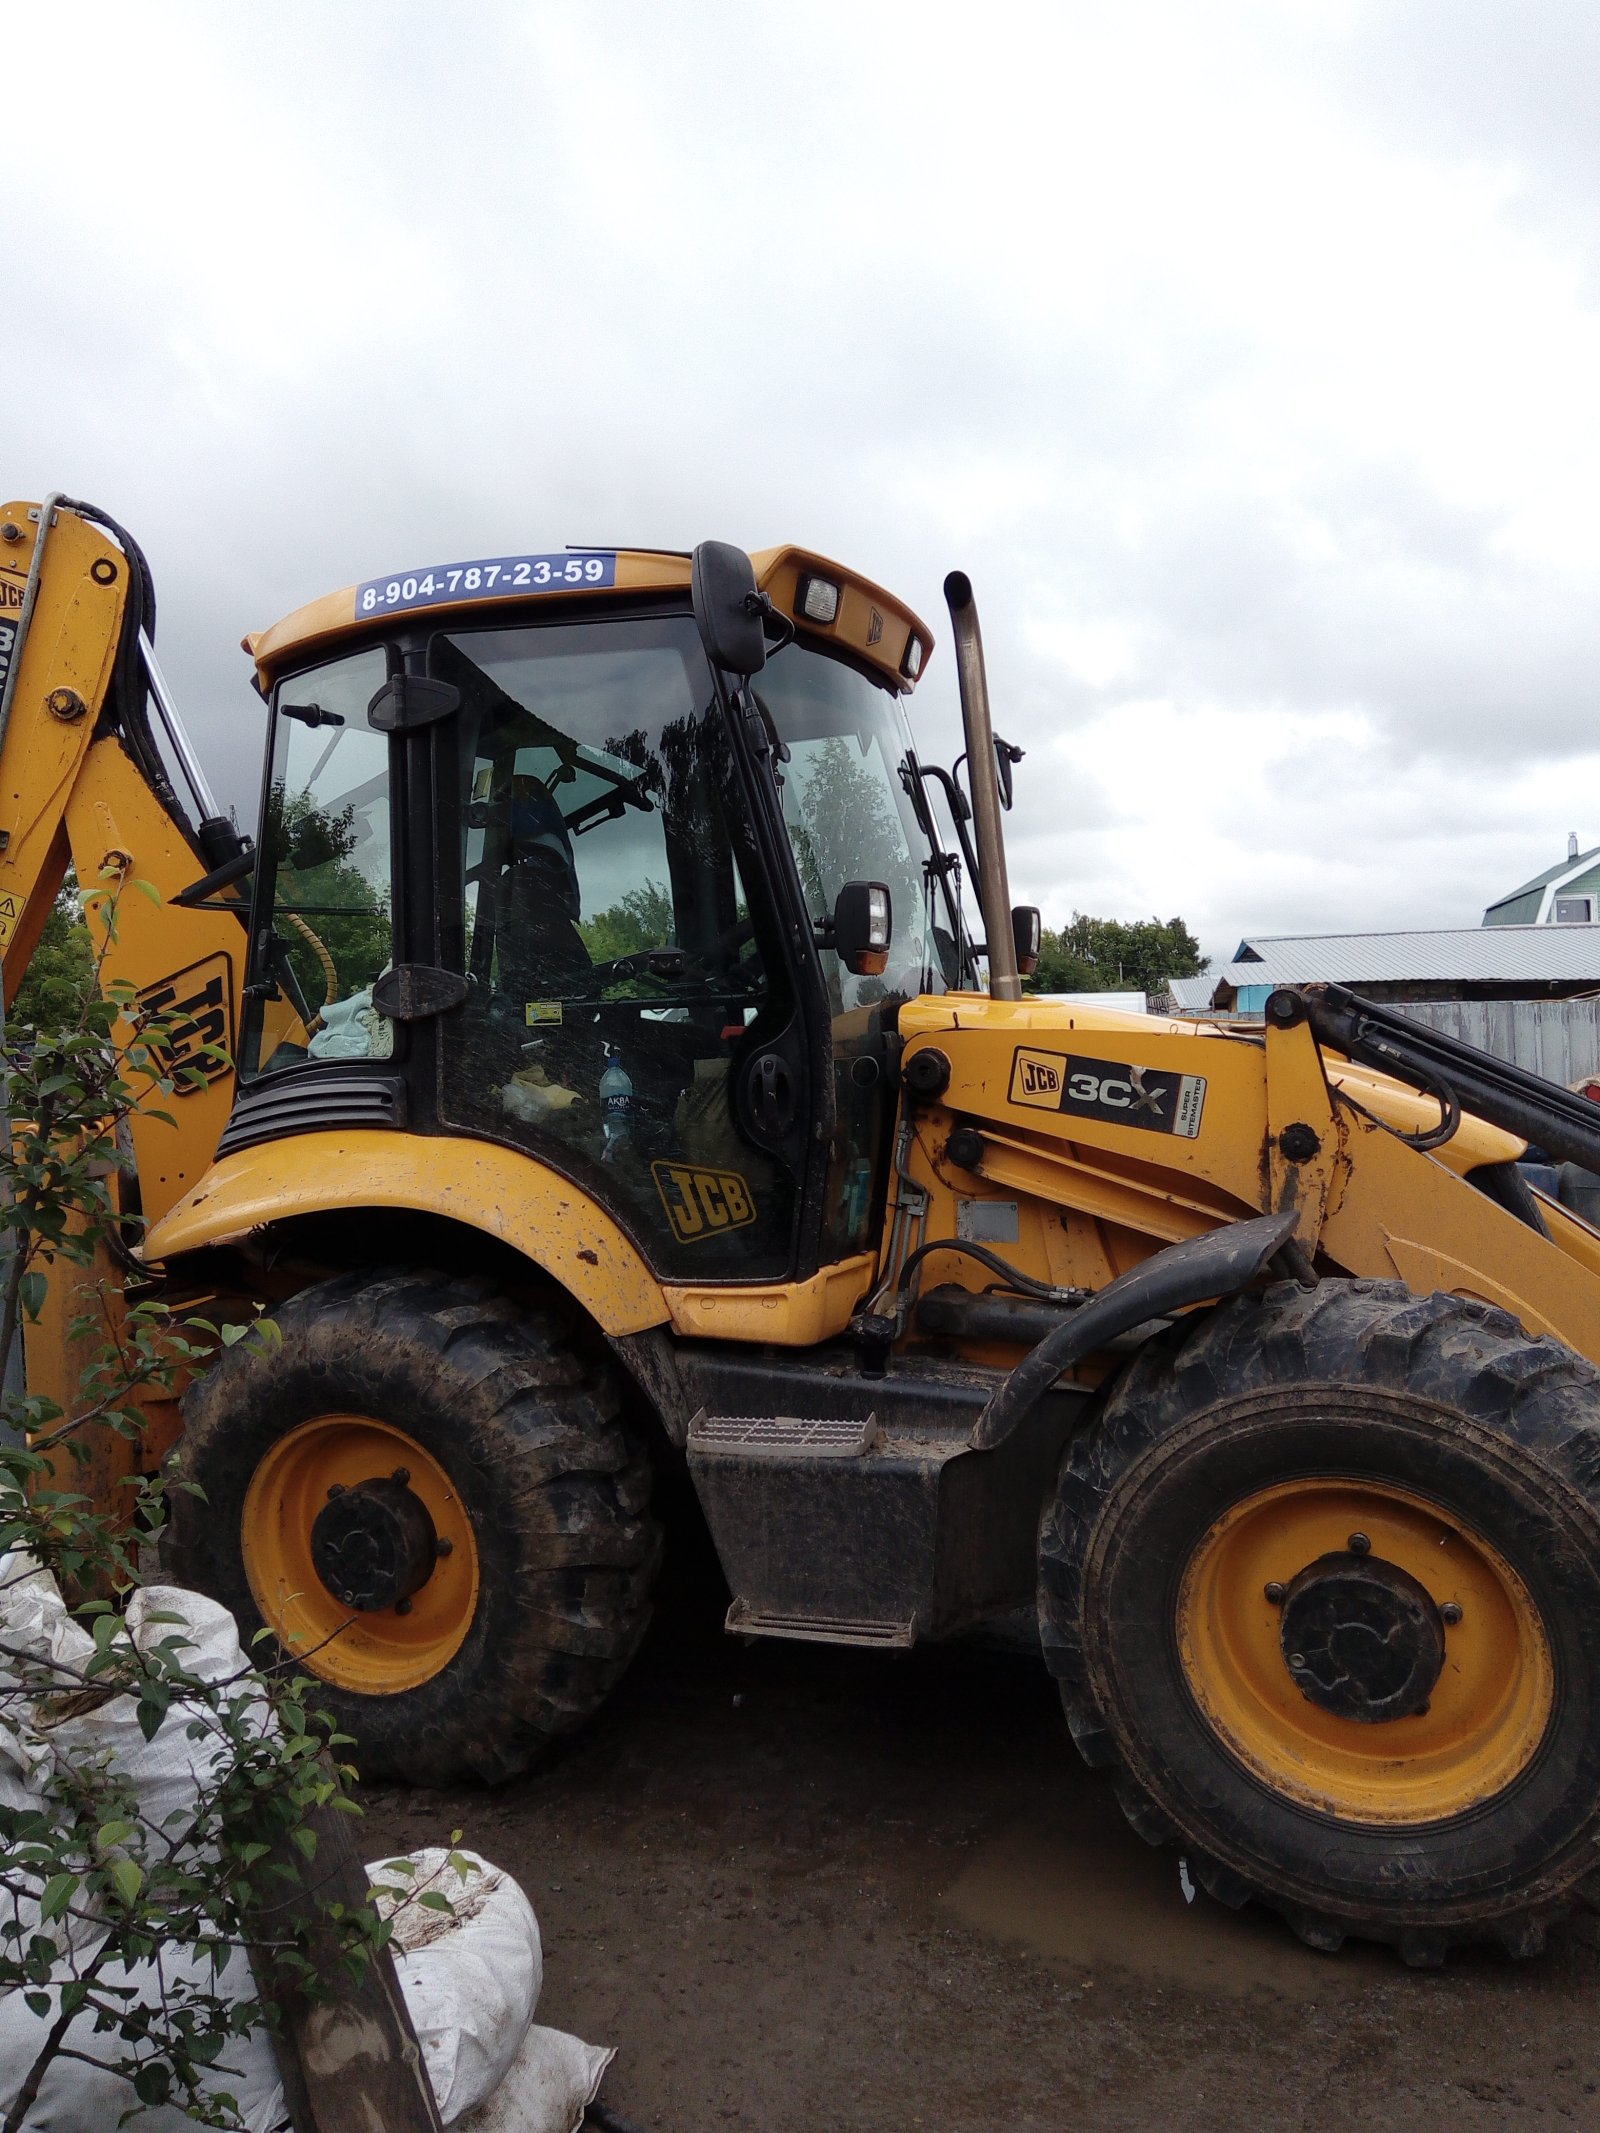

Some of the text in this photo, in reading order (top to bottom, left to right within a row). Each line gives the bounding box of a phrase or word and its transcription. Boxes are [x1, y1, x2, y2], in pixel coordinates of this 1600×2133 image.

[362, 559, 604, 611] 8-904-787-23-59
[1025, 1063, 1168, 1115] JCB 3CX
[1181, 1090, 1191, 1121] SUPER
[1187, 1079, 1201, 1136] SITEMASTER
[670, 1169, 751, 1234] JCB
